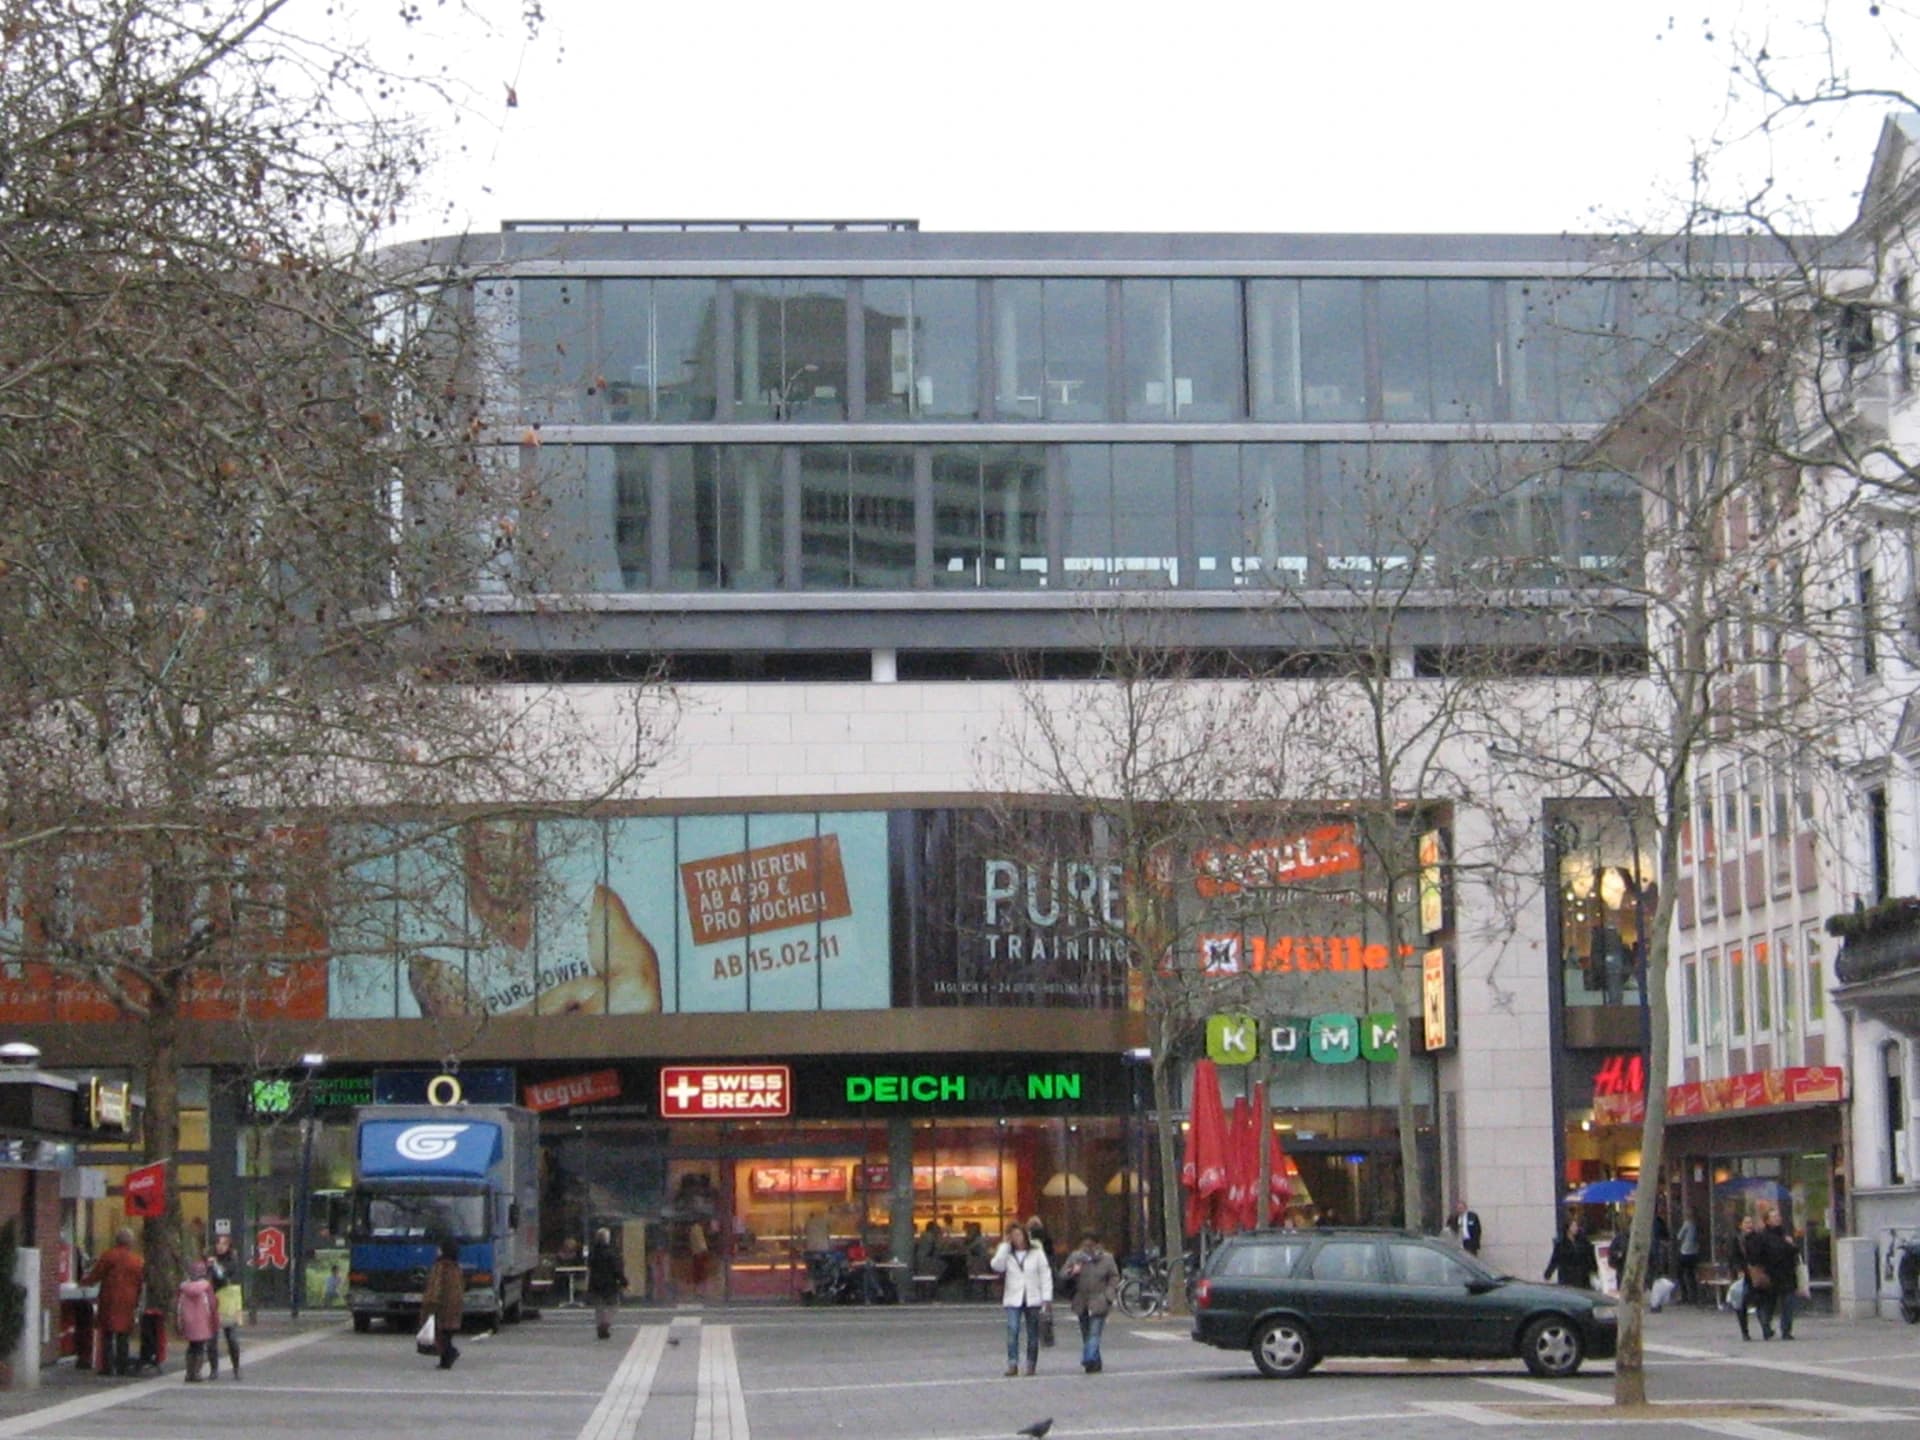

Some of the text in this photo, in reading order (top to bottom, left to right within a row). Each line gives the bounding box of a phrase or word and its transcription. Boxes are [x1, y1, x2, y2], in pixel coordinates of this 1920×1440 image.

[695, 852, 807, 890] TRAINIEREN
[700, 876, 790, 912] AB 4.99 €
[702, 891, 827, 933] PRO WOCHE!!
[984, 859, 1125, 929] PURE
[713, 935, 840, 980] AB 15.02.11
[985, 933, 1129, 961] TRAINING
[702, 1074, 783, 1090] SWISS
[702, 1092, 783, 1108] BREAK
